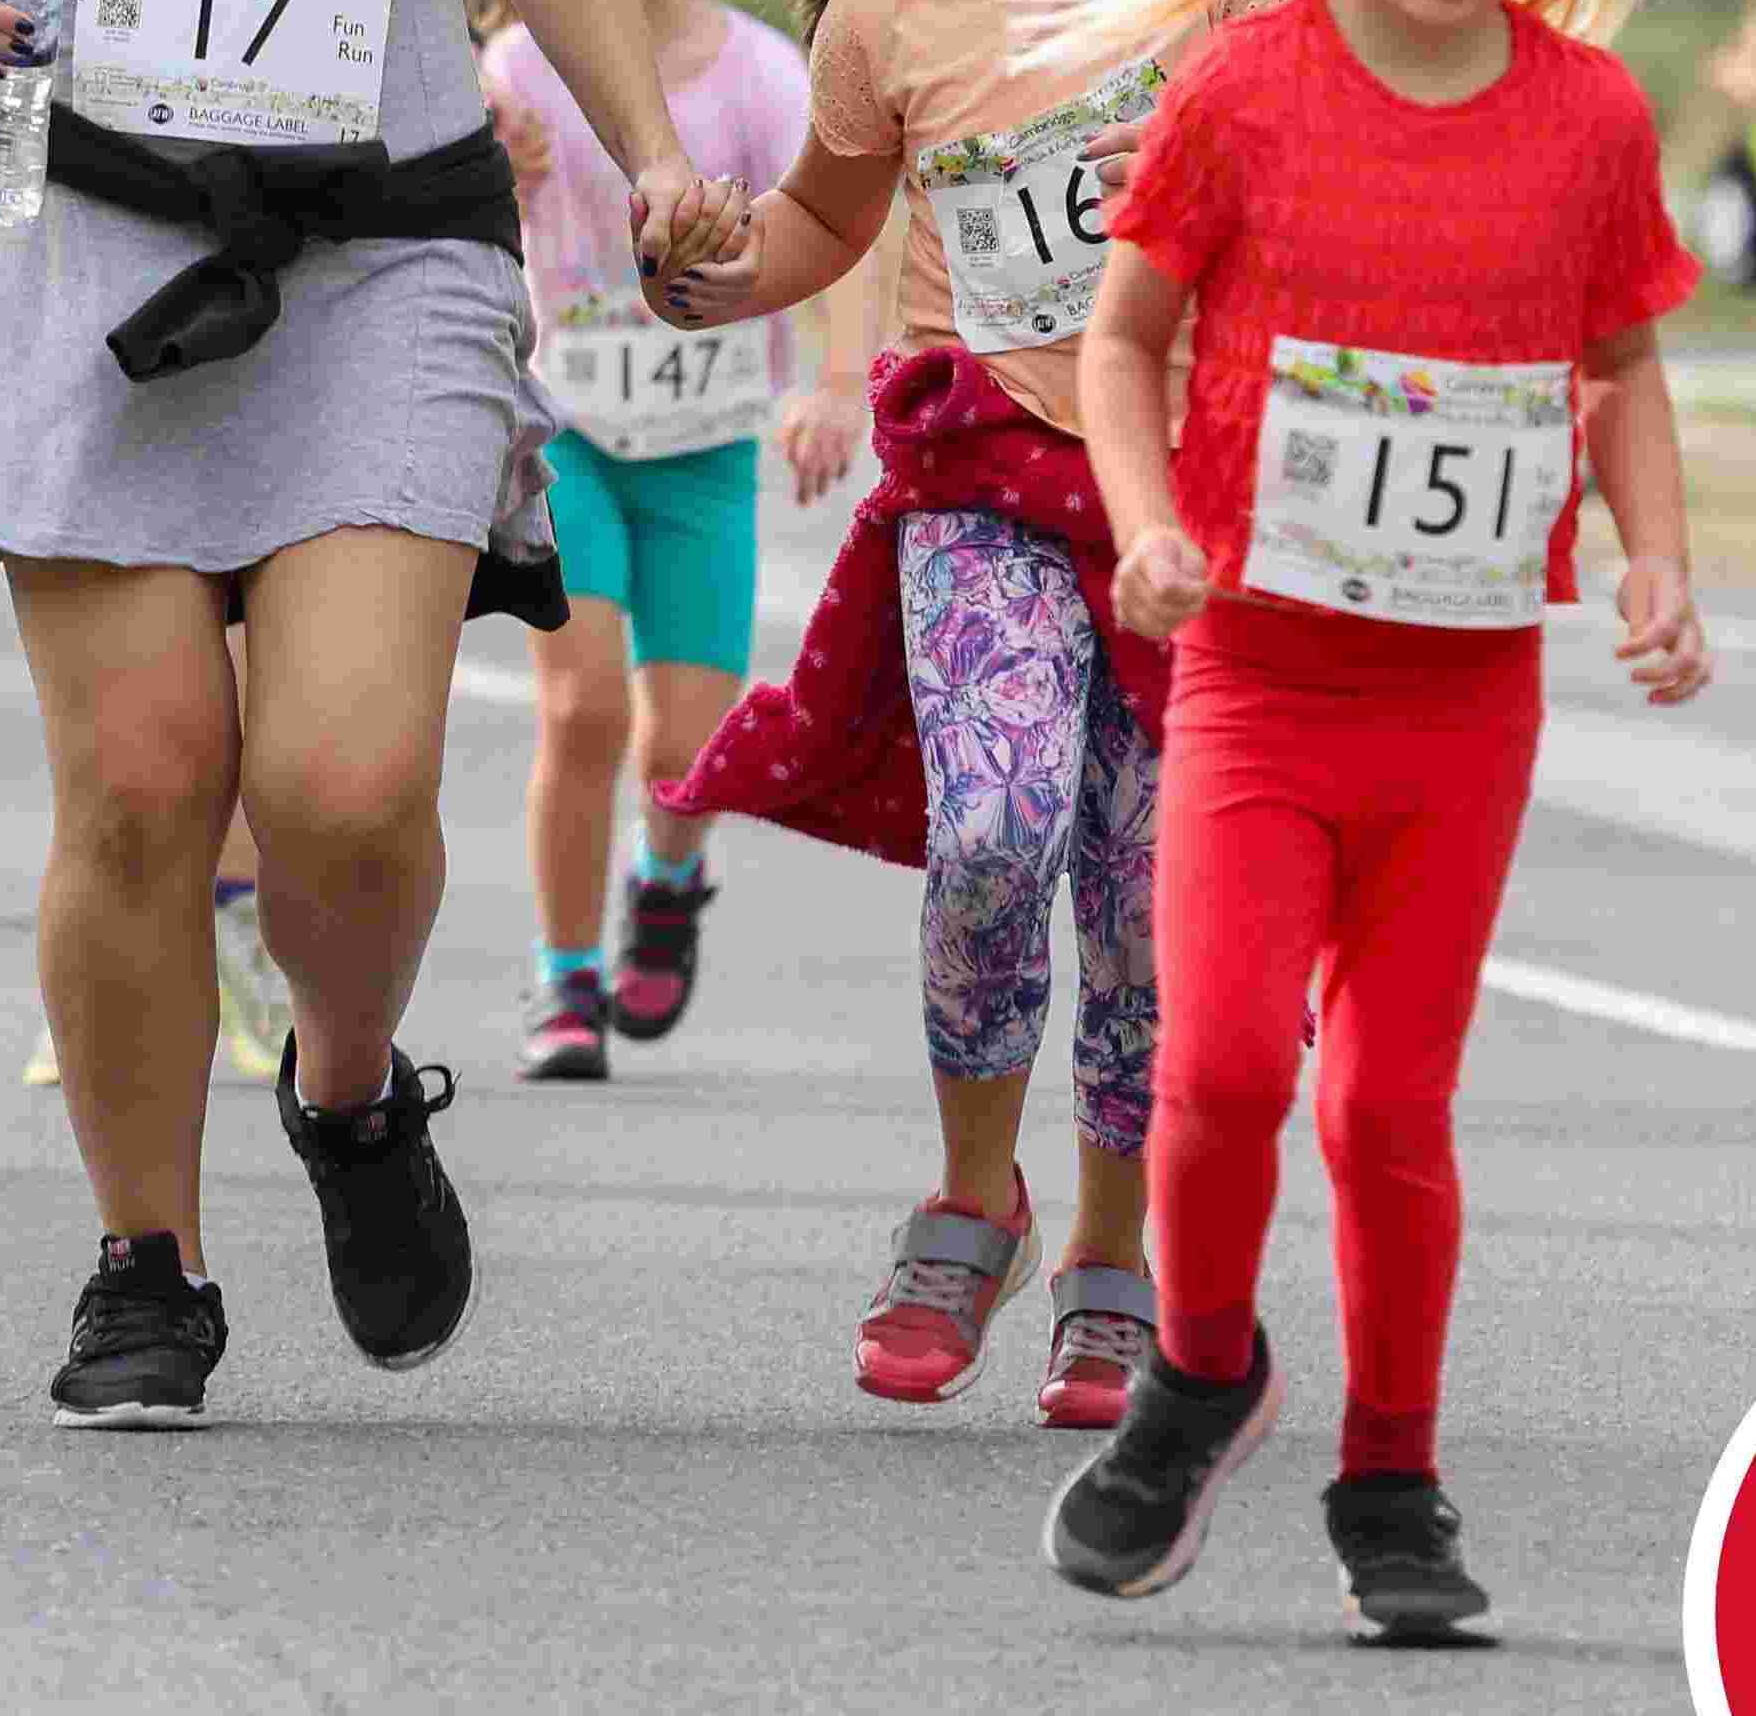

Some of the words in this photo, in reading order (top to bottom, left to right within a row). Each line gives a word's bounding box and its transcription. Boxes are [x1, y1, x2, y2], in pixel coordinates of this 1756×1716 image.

[333, 14, 365, 38] Fun
[338, 40, 374, 65] Run
[189, 107, 262, 129] BAGGAGE
[267, 114, 309, 133] LABEL
[620, 338, 722, 401] 147
[1366, 436, 1515, 541] 151
